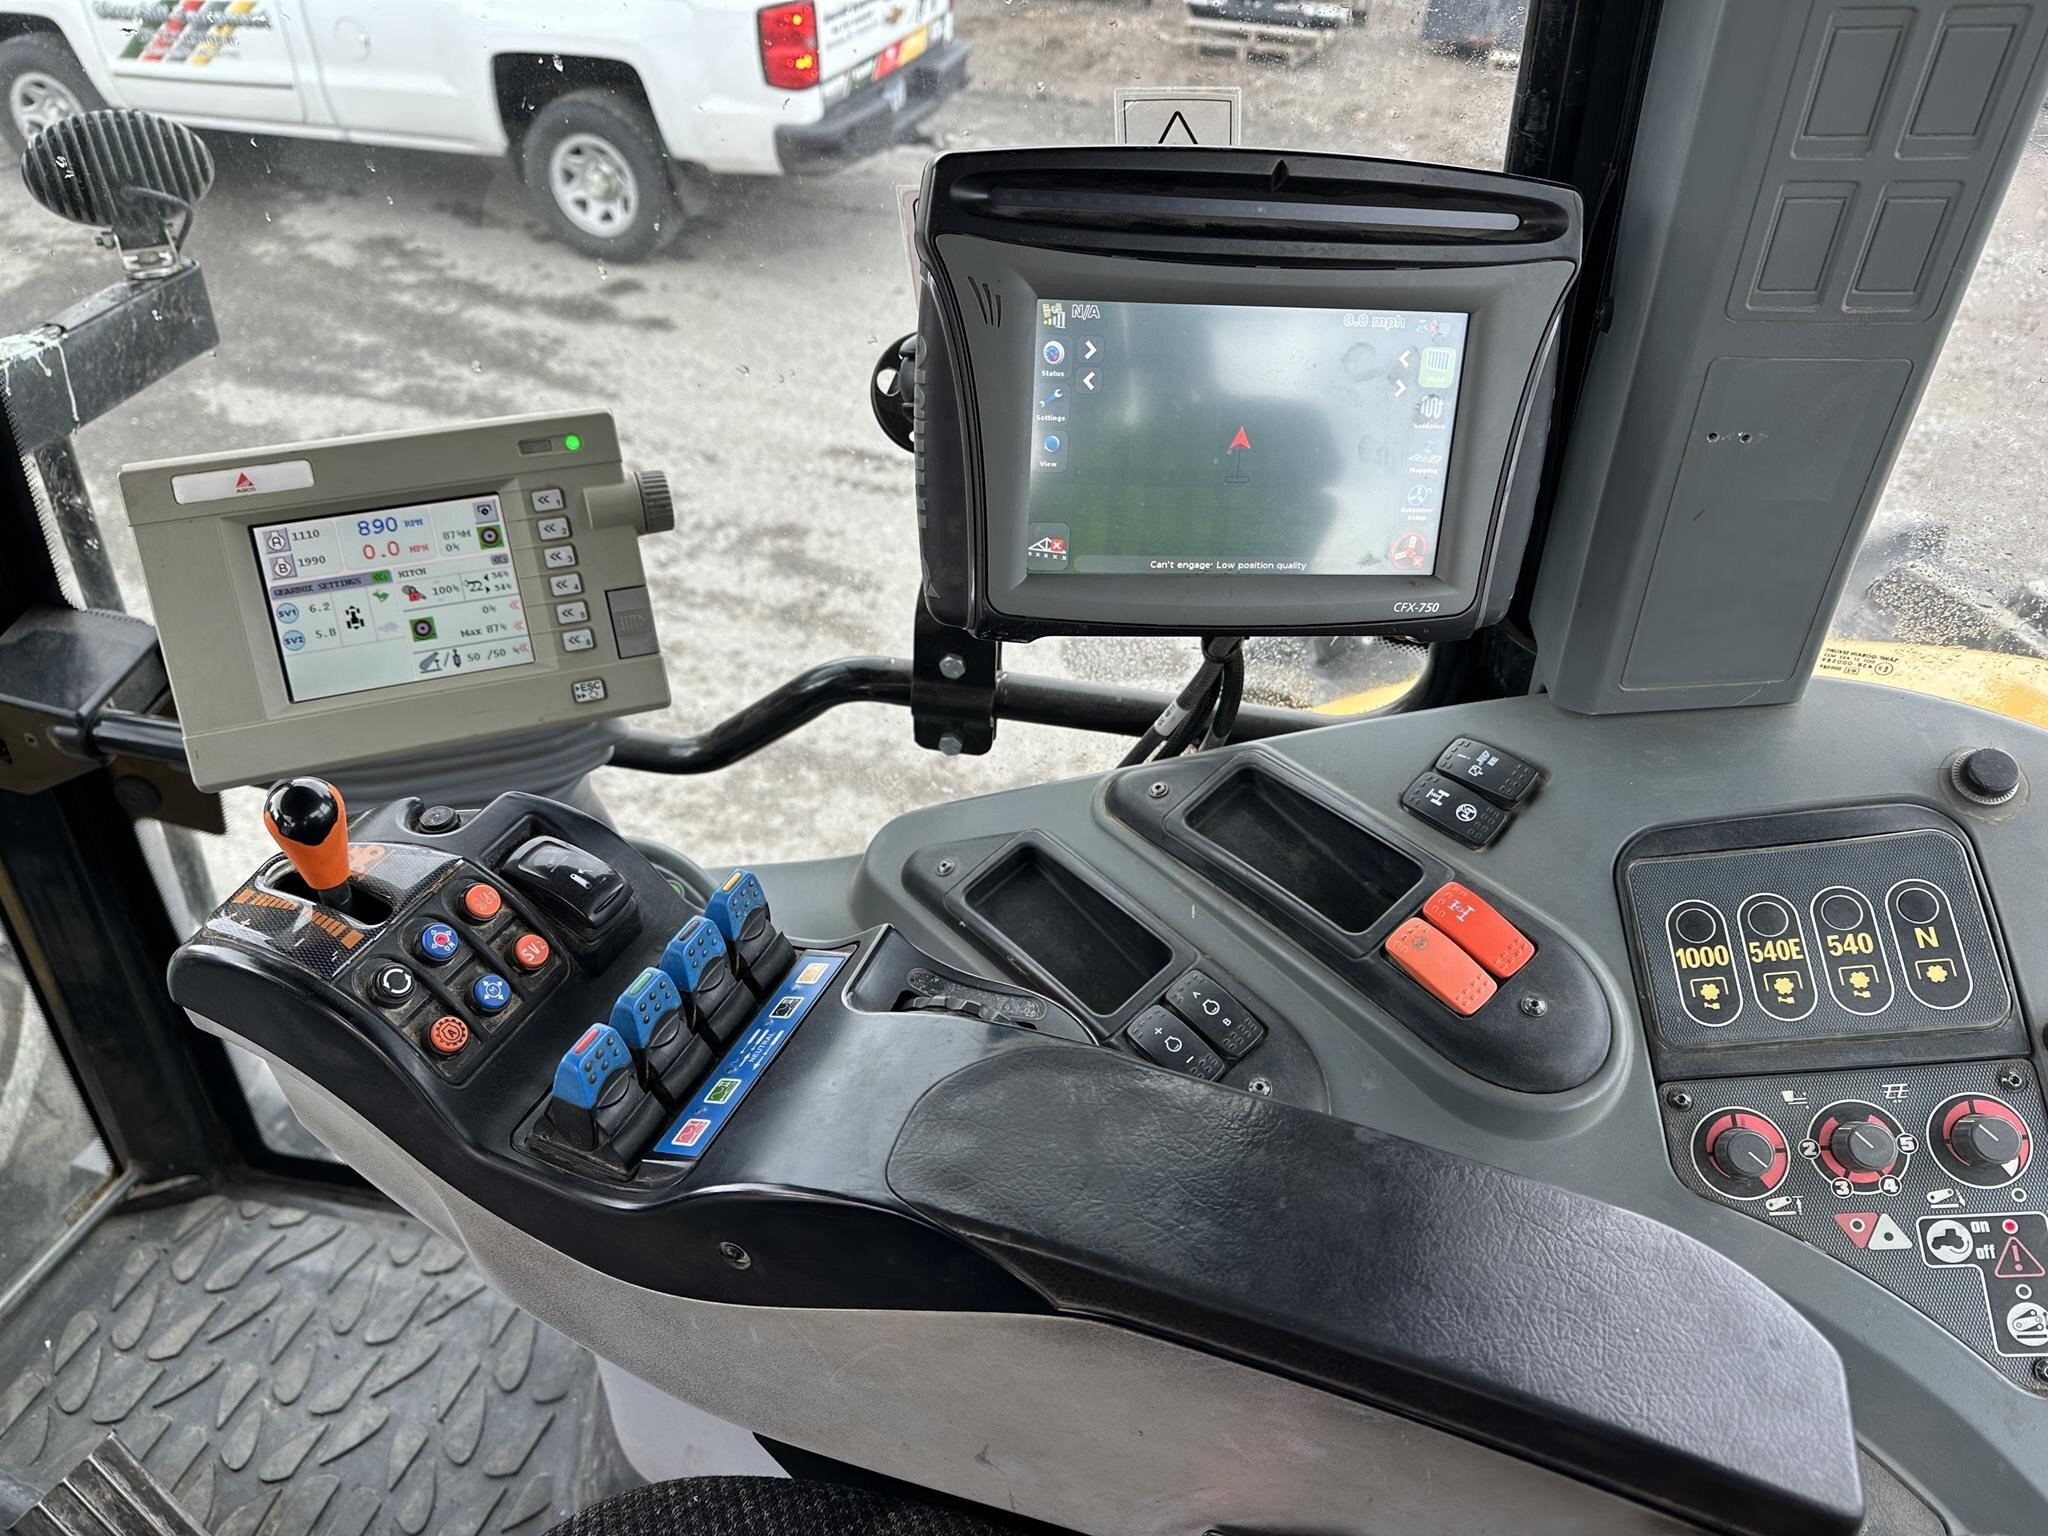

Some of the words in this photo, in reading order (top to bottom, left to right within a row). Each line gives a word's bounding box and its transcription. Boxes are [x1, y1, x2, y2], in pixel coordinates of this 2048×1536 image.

[1072, 304, 1100, 320] N/A
[1343, 314, 1368, 327] 0.0
[1372, 315, 1405, 330] mph
[1036, 414, 1065, 422] Settings
[357, 517, 398, 536] 890
[404, 518, 423, 528] RPM
[292, 529, 320, 540] 1110
[272, 536, 281, 547] A
[363, 541, 400, 560] 0.0
[409, 544, 429, 553] MPH
[298, 555, 326, 567] 1990
[1150, 561, 1174, 569] Can't
[1238, 562, 1274, 570] position
[1277, 562, 1307, 571] quality
[278, 563, 288, 574] B
[398, 568, 426, 578] HITCH
[278, 609, 296, 618] SV1
[309, 602, 330, 613] 6.2
[1393, 602, 1440, 613] CFX-750
[316, 628, 336, 639] 5.8
[460, 629, 482, 638] Max
[467, 652, 480, 662] 50
[580, 680, 601, 692] ESC
[1914, 926, 1939, 949] N
[444, 941, 456, 952] ON
[1826, 932, 1873, 956] 540
[520, 940, 546, 961] SV2
[1676, 944, 1729, 969] 1000
[1749, 938, 1804, 963] 540E
[1193, 991, 1202, 999] A
[1222, 1018, 1231, 1026] B
[448, 1029, 457, 1038] A
[748, 1032, 775, 1063] NEUTRAL
[1803, 1142, 1815, 1155] 2
[1900, 1137, 1912, 1150] 5
[1836, 1180, 1848, 1193] 3
[1884, 1179, 1896, 1193] 4
[1970, 1221, 1990, 1233] on
[1976, 1244, 1996, 1259] off
